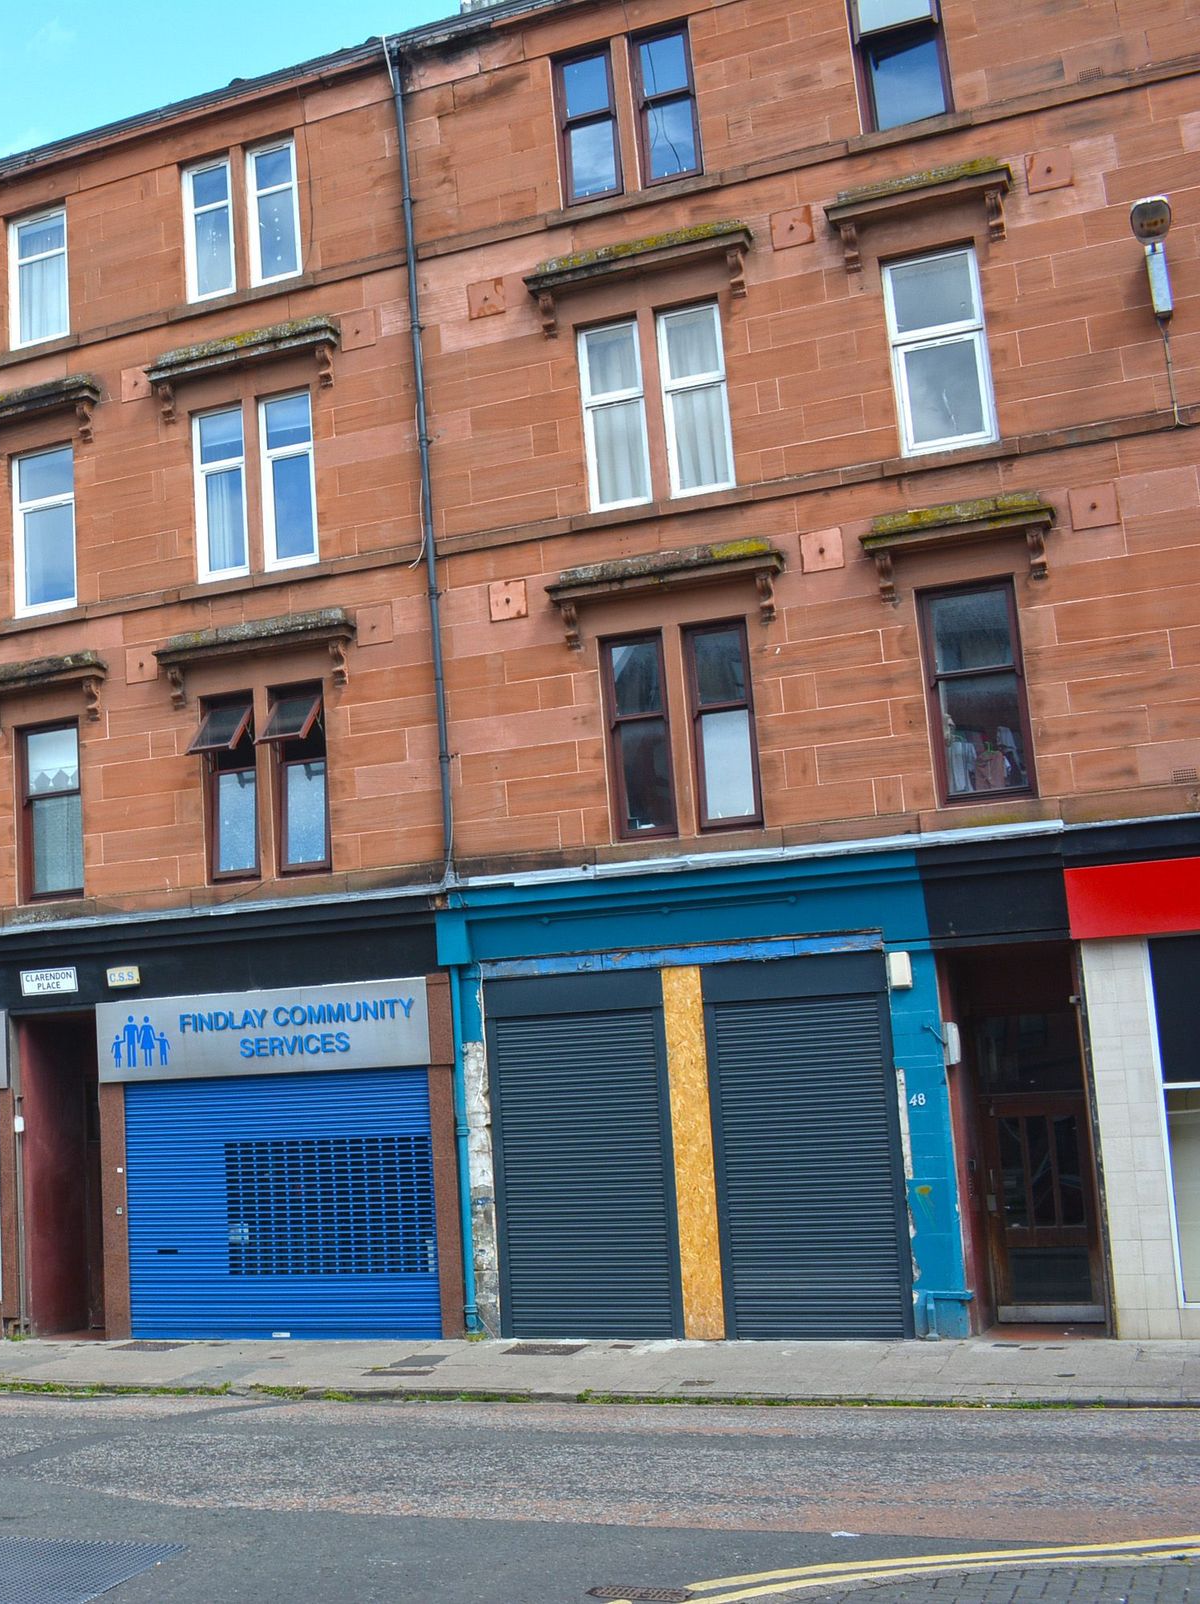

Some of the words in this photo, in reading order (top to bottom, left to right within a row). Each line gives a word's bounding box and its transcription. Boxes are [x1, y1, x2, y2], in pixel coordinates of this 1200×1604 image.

[25, 970, 72, 983] CLARENDON
[37, 980, 61, 990] PLACE
[179, 1008, 267, 1034] FINDLAY
[273, 997, 414, 1027] COMMUNITY
[239, 1031, 351, 1058] SERVICES
[909, 1093, 926, 1106] 48
